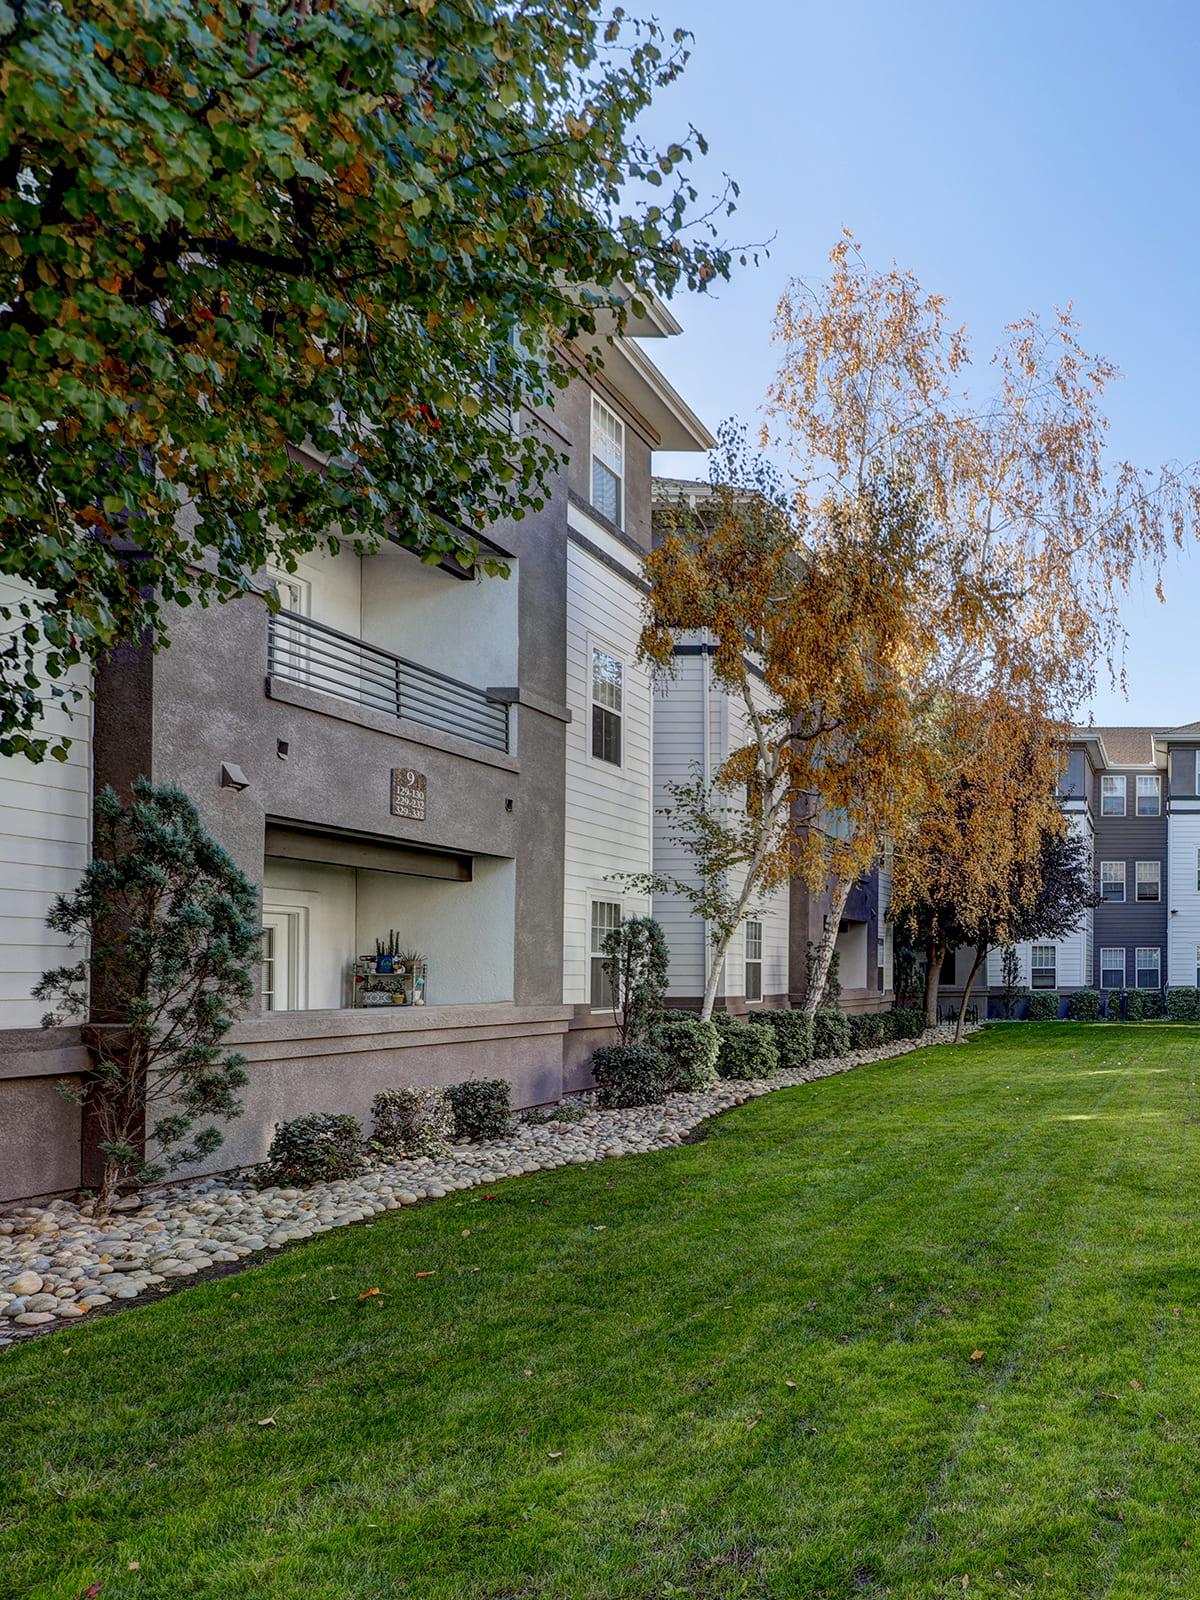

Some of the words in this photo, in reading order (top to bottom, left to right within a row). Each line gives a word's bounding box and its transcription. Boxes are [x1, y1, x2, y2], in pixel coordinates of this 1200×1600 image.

[406, 771, 415, 786] 9
[396, 786, 424, 800] 129-130
[395, 795, 424, 810] 229-232
[395, 805, 424, 819] 329-332
